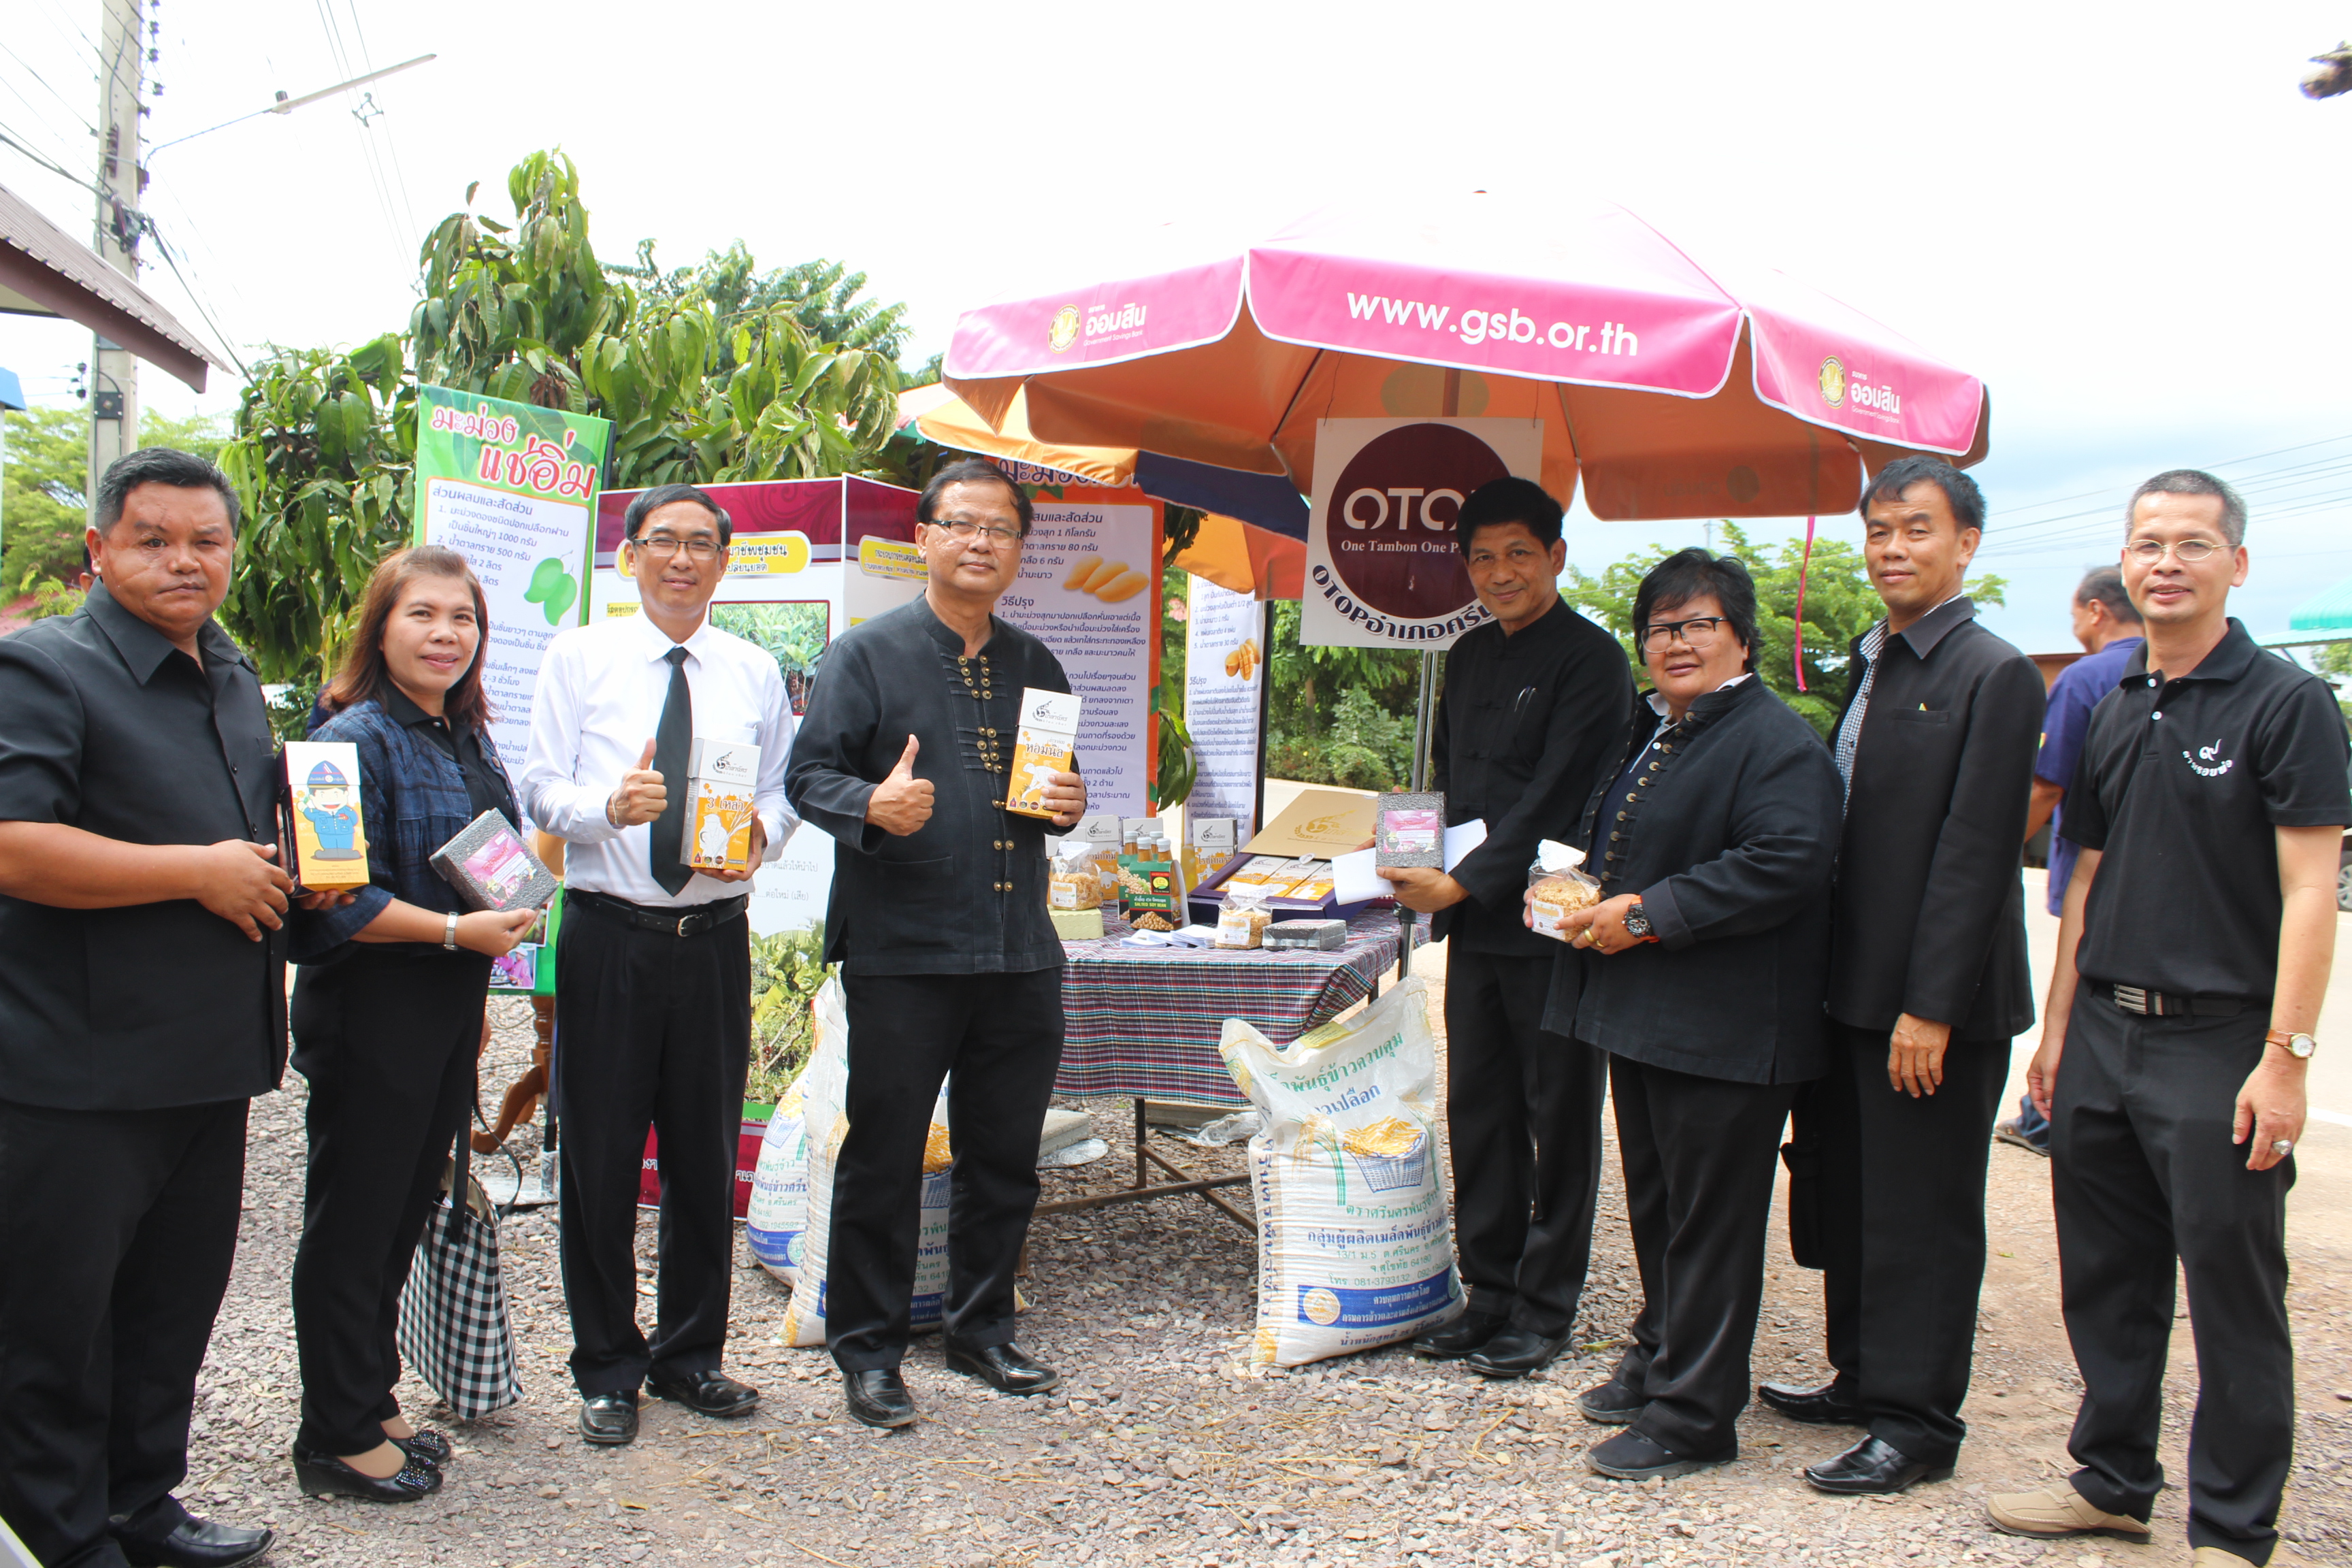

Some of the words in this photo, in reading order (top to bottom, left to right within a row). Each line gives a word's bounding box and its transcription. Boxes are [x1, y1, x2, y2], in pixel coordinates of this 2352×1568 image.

[1085, 302, 1147, 336] ออมสิน
[1347, 292, 1638, 356] www.gsb.or.th
[1083, 336, 1112, 346] Government
[1113, 332, 1131, 341] Savings
[1131, 329, 1143, 338] Bank
[1850, 382, 1900, 414] ออมสิน
[432, 403, 517, 444] มะม่วง
[479, 431, 596, 499] แช่อิ่ม
[433, 486, 533, 515] ส่วนผสมและสัดส่วน
[438, 505, 446, 514] 1.
[1343, 487, 1469, 532] OTO
[1033, 512, 1102, 523] สมและสัดส่วน
[498, 532, 519, 544] 1000
[520, 536, 538, 547] กรัม
[1065, 527, 1096, 538] กิโลกรัม
[437, 535, 445, 544] 2.
[448, 534, 495, 554] น้ำตาลทราย
[496, 547, 512, 557] 500
[514, 551, 531, 561] กรัม
[1081, 543, 1098, 552] กรัม
[1341, 540, 1365, 552] One
[1368, 540, 1418, 553] Tambon
[1421, 542, 1447, 553] One
[478, 559, 485, 567] 2
[486, 559, 502, 571] ลิตร
[727, 557, 767, 572] ปลี่ยนยอด
[1020, 555, 1038, 564] กลือ
[1047, 557, 1064, 565] กรัม
[483, 574, 499, 586] ลิตร
[1001, 595, 1034, 610] วิธีปรุง
[489, 621, 526, 637] ป็นชิ้นยาวๆ
[527, 630, 556, 640] ตามลูก
[1065, 648, 1082, 656] เกลือ
[498, 673, 520, 686] ชั่วโมง
[1079, 719, 1128, 728] ะม่วงกวนละเลง
[708, 797, 715, 808] 3
[719, 798, 744, 811] เหล่า
[1315, 1085, 1381, 1115] วเปลือก
